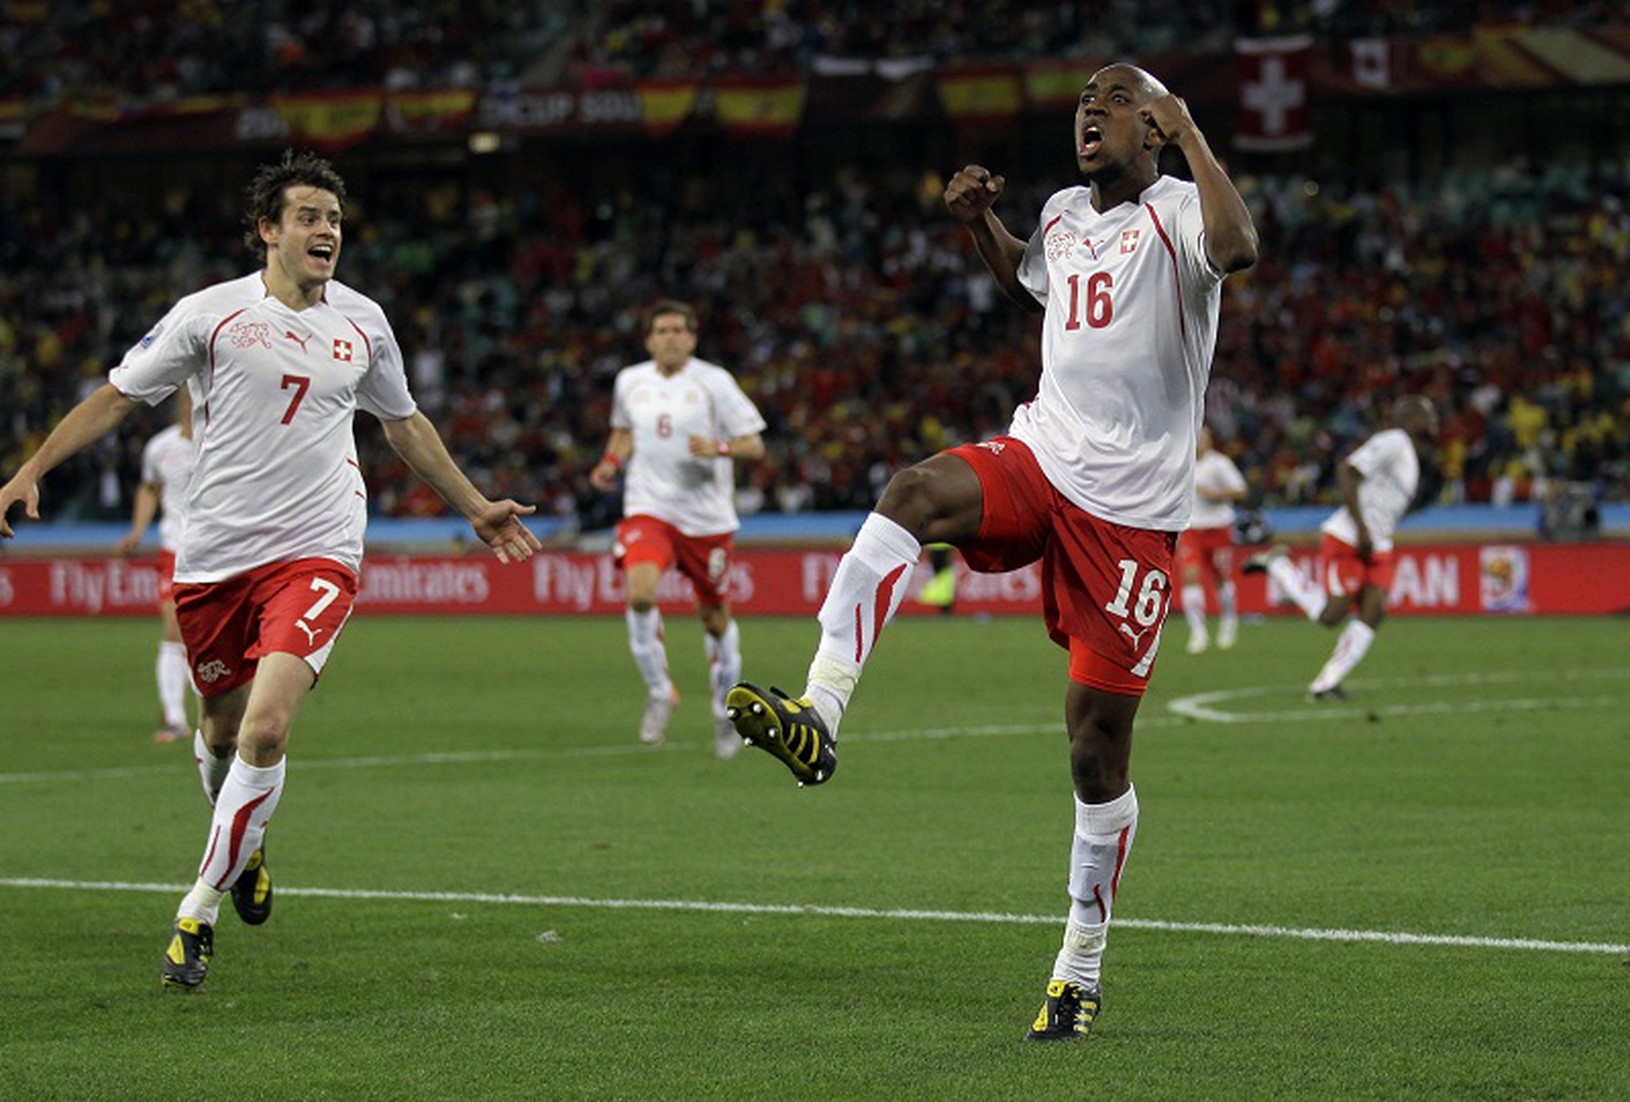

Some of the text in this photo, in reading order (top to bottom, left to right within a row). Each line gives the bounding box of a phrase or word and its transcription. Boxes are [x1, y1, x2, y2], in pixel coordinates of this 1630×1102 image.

[1065, 271, 1114, 332] 16
[280, 374, 310, 426] 7
[658, 413, 671, 439] 6
[305, 576, 340, 620] 7
[1105, 559, 1167, 627] 16
